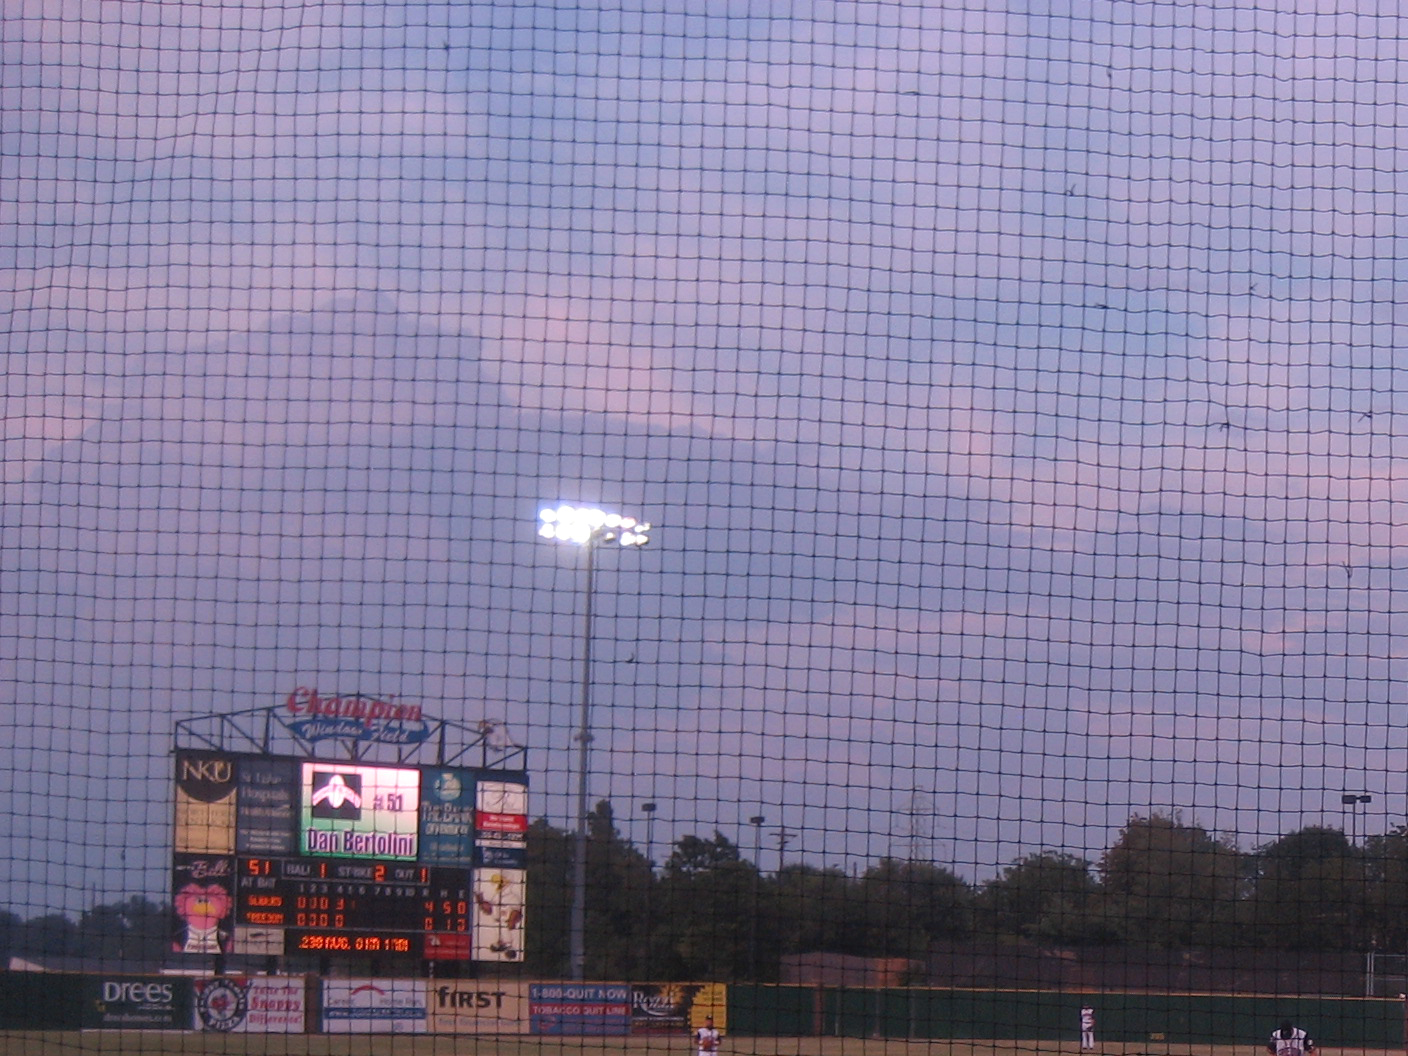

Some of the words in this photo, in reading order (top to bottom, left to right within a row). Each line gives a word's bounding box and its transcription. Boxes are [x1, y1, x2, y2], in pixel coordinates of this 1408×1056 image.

[287, 686, 421, 728] Champion
[183, 760, 232, 783] NKU
[307, 829, 338, 852] Dan
[343, 831, 414, 856] Bertolini
[247, 860, 271, 876] 51
[286, 864, 311, 876] BALL
[320, 863, 327, 878] 1
[338, 866, 373, 879] STRIKE
[374, 865, 385, 882] 2
[395, 869, 415, 880] OUT
[420, 868, 427, 883] 1
[241, 877, 253, 888] AT
[256, 878, 276, 889] BAT
[104, 982, 173, 1002] Drees
[598, 989, 627, 999] NOW
[533, 1006, 580, 1015] TOBACCO
[583, 1006, 604, 1015] QUIT
[606, 1007, 626, 1015] LINE
